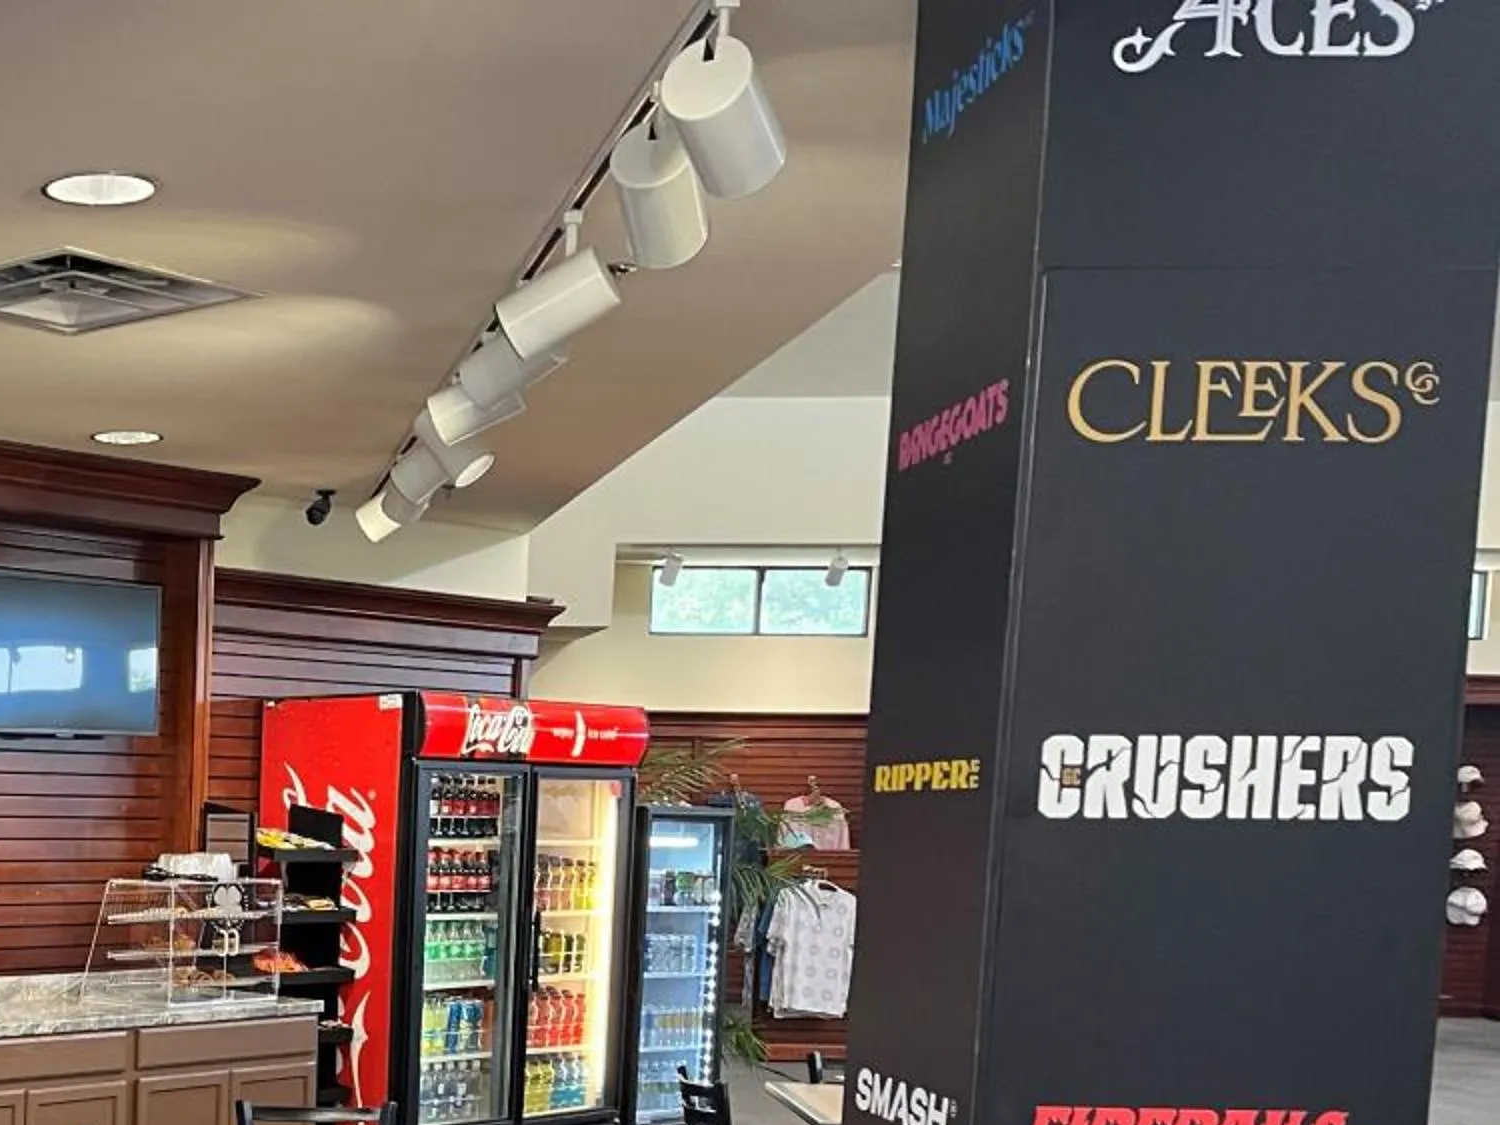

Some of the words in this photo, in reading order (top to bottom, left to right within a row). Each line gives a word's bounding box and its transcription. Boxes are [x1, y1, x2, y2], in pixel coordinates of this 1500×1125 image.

[1067, 360, 1402, 443] CLEEKS
[875, 760, 969, 792] RIPPER
[1037, 734, 1415, 821] CRUSHERS
